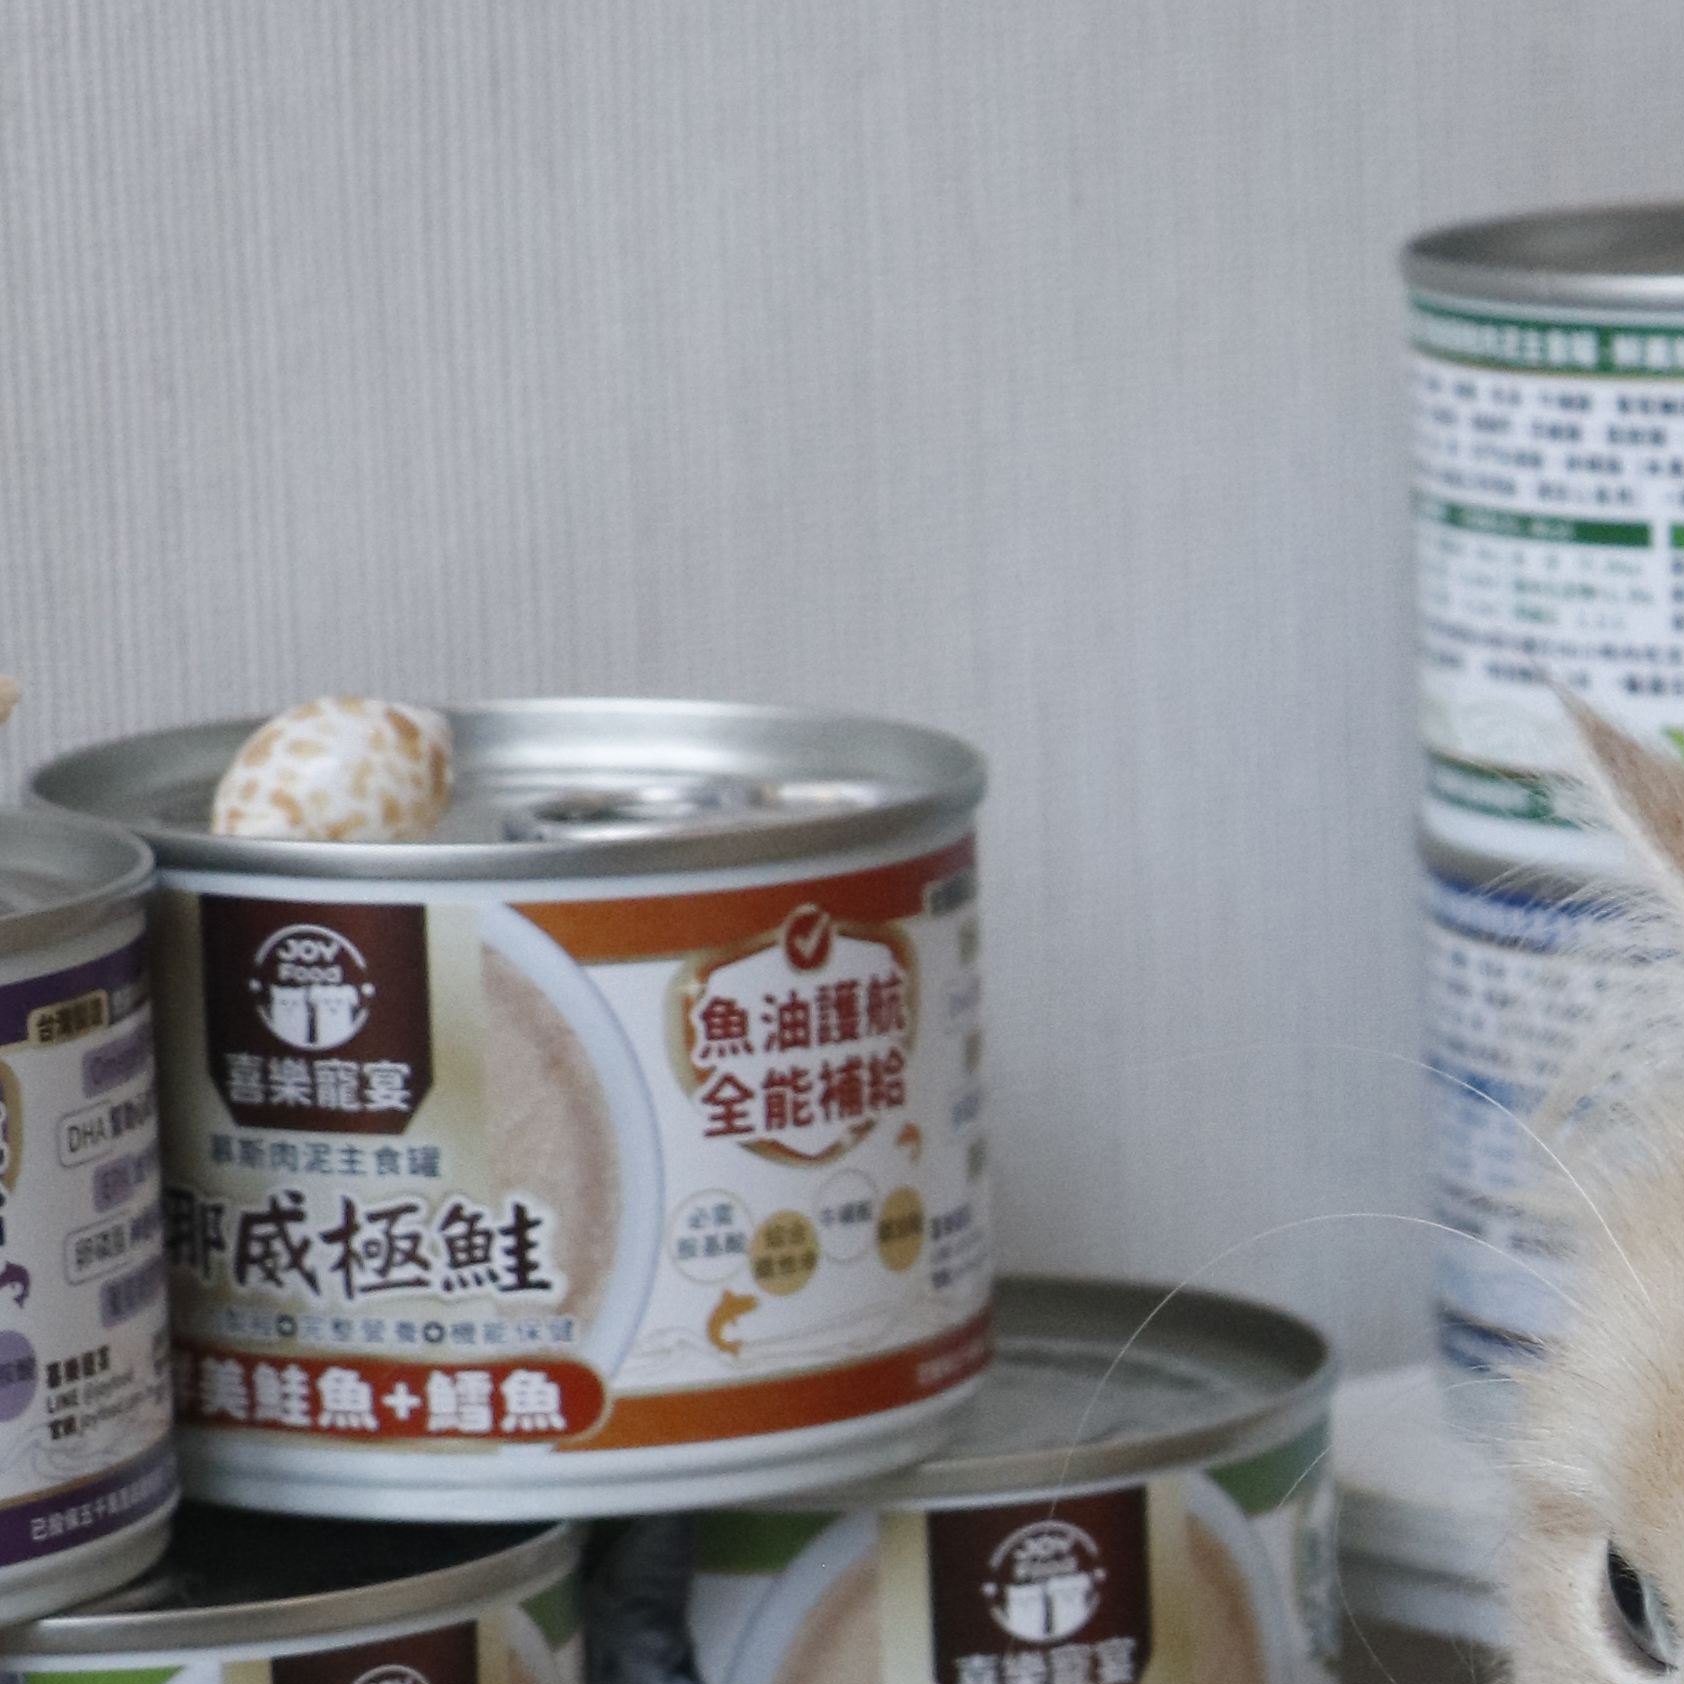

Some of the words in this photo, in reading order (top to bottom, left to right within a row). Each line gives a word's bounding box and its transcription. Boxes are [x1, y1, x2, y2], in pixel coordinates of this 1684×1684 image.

[277, 938, 339, 961] JOY
[226, 1052, 412, 1113] 喜樂寵宴
